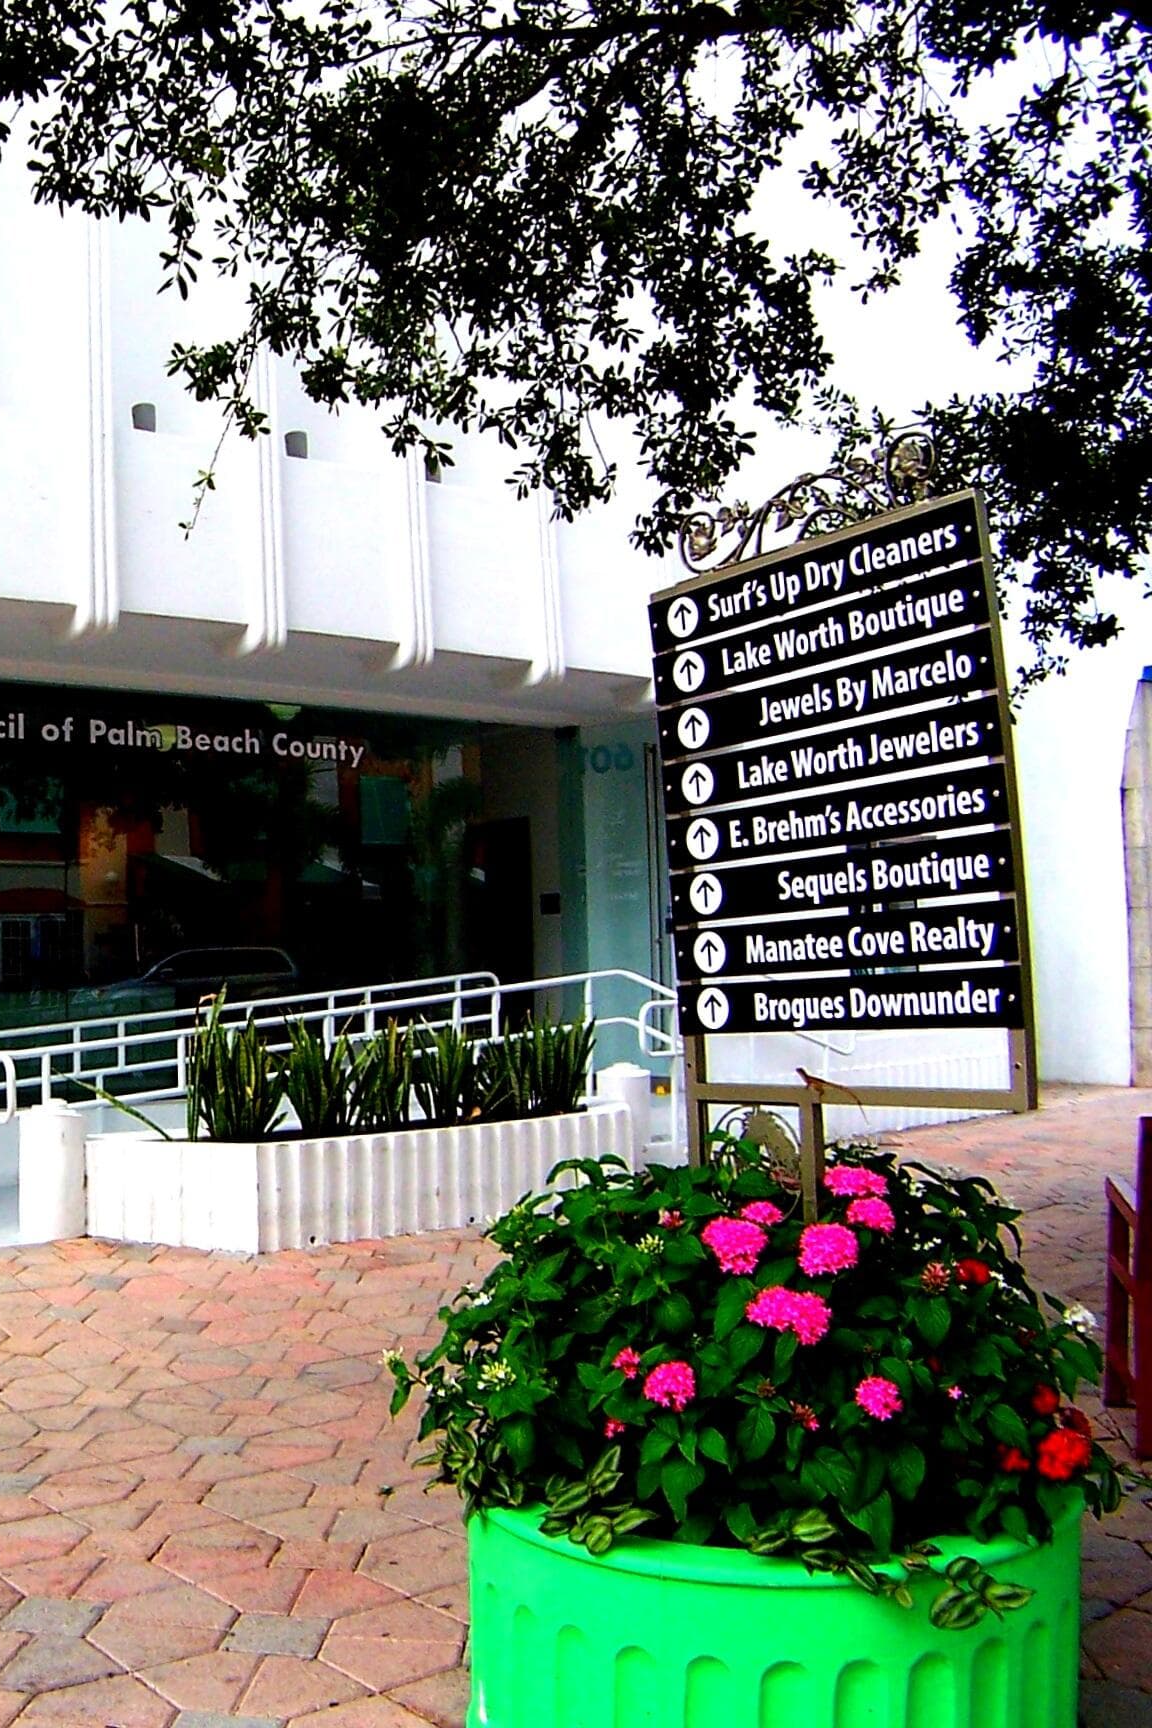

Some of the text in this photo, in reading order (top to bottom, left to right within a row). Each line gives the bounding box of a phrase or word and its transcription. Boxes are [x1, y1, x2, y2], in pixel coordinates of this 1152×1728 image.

[708, 523, 957, 621] Surf's Up Dry Cleaners
[722, 586, 963, 675] Lake Worth Boutique
[760, 650, 971, 726] Jewels By Marcelo
[42, 718, 73, 741] of
[91, 720, 160, 747] Palm
[177, 726, 259, 753] Beach
[273, 733, 363, 767] County
[738, 721, 978, 788] Lake Worth Jewelers
[730, 785, 985, 848] E. Brehm's Accessories
[778, 852, 989, 904] Sequels Boutique
[746, 917, 994, 963] Manatee Cove Realty
[754, 981, 999, 1027] Brogues Downunder
